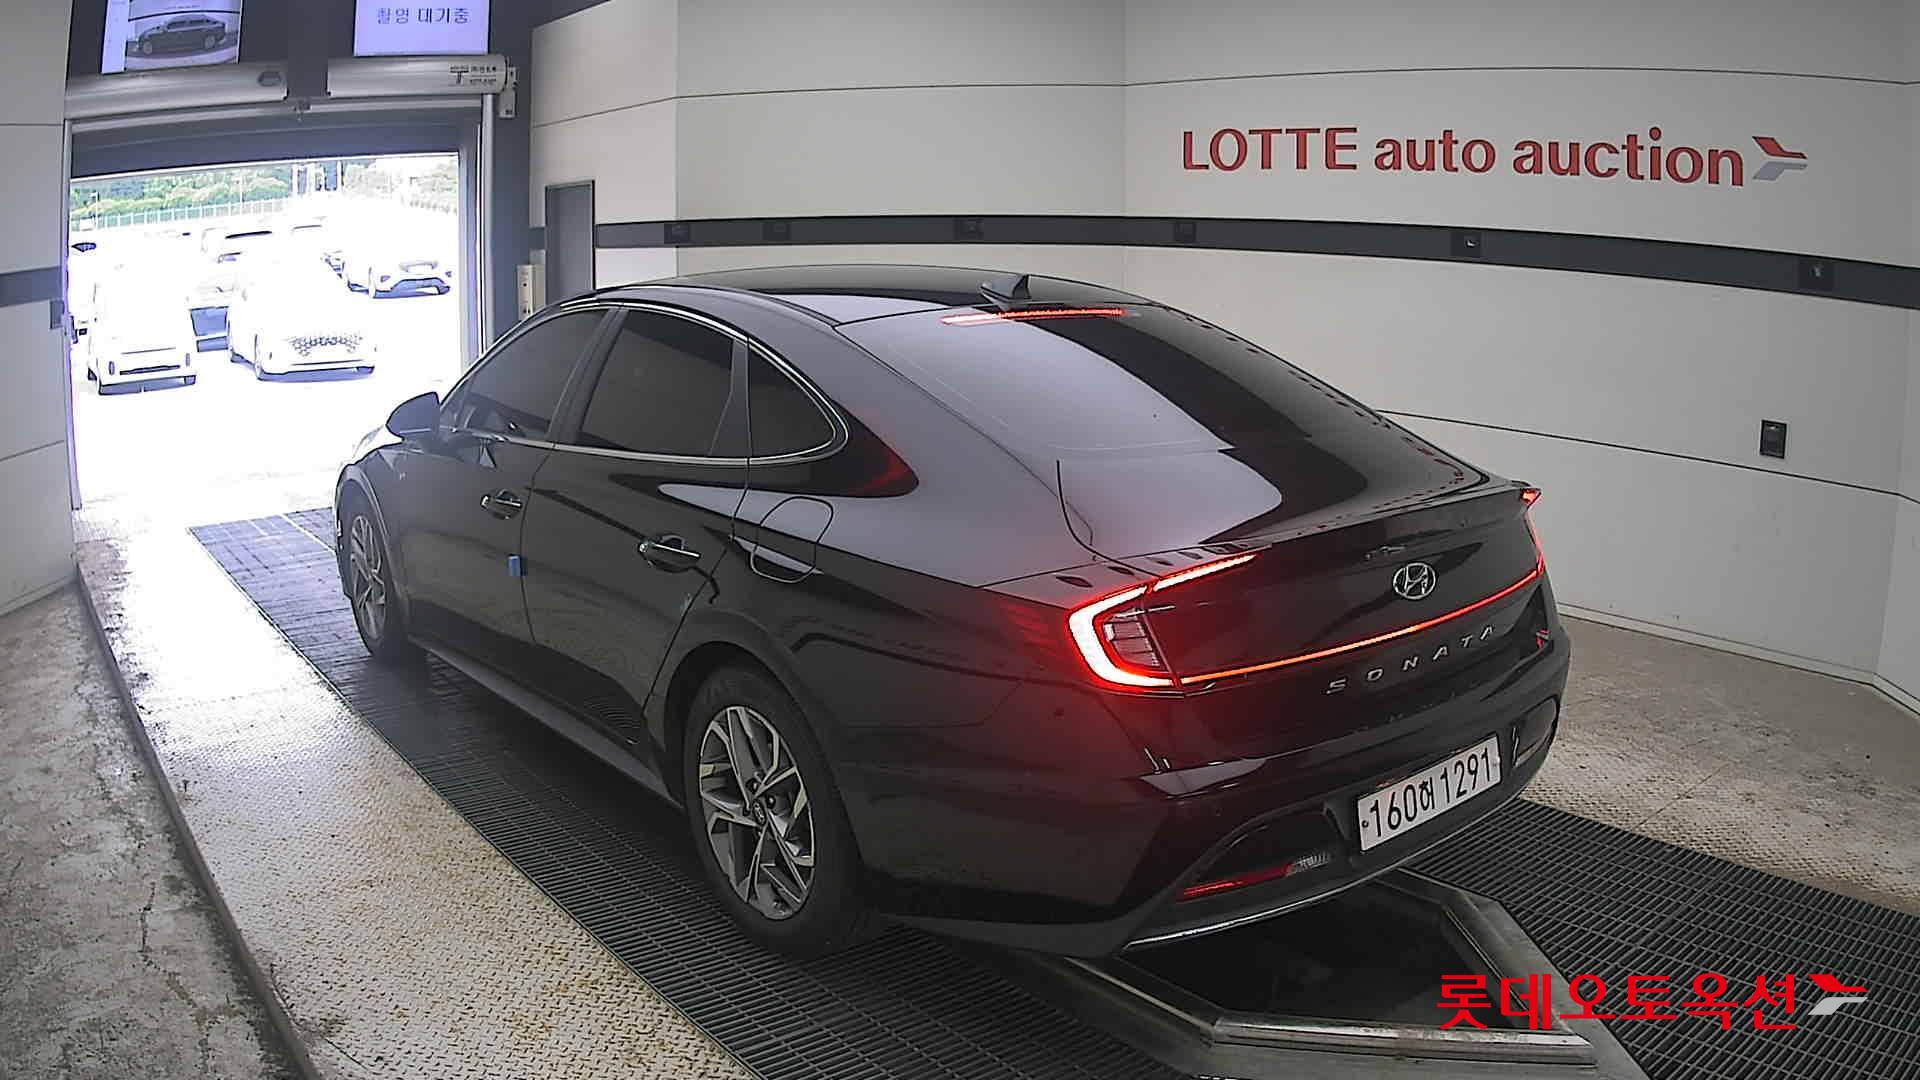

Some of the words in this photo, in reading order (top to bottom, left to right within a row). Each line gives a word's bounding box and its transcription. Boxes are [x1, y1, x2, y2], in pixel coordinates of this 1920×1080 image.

[417, 8, 469, 24] 대기중
[1183, 127, 1358, 172] LOTTE
[1375, 128, 1496, 173] auto
[1512, 126, 1744, 187] auction
[1325, 624, 1495, 695] SONATA
[1369, 776, 1436, 838] 160허
[1439, 747, 1491, 804] 1291
